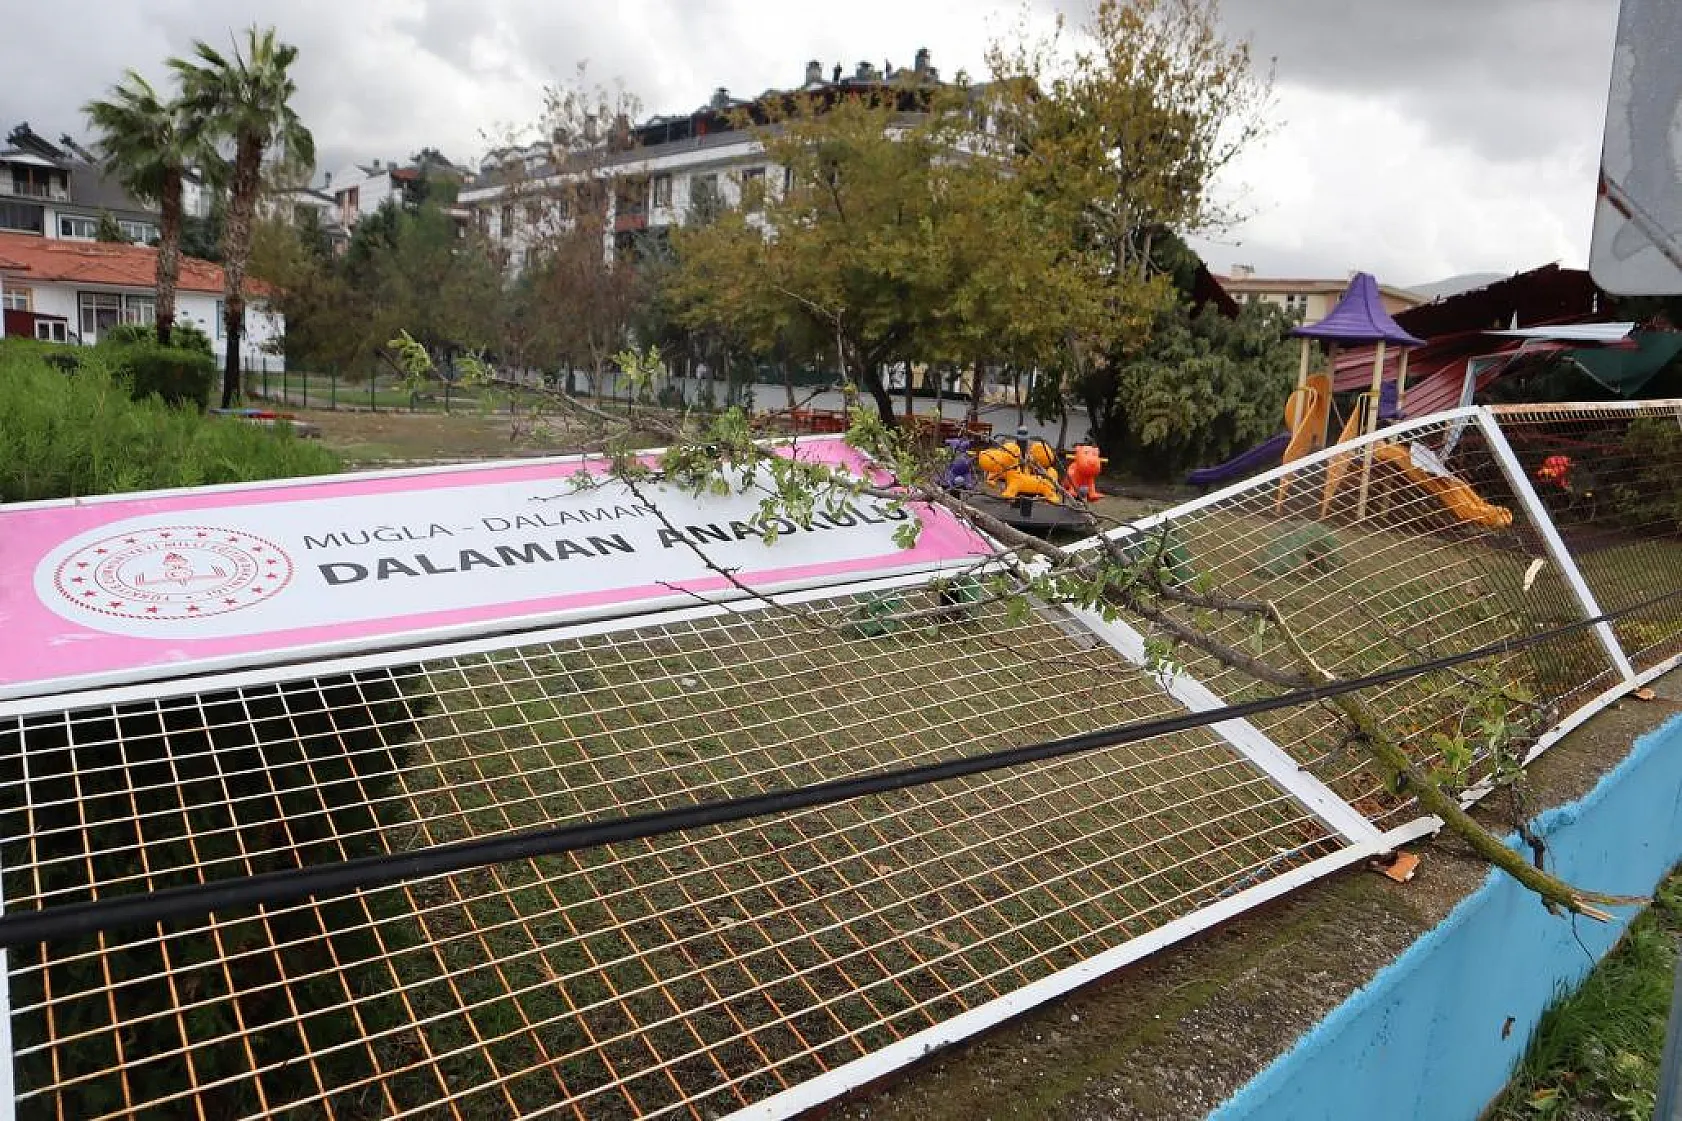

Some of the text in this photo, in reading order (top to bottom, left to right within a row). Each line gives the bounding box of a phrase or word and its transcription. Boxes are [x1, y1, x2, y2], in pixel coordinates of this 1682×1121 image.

[303, 523, 455, 550] MUĞLA
[482, 503, 657, 532] DALAMAN
[317, 533, 637, 586] DALAMAN
